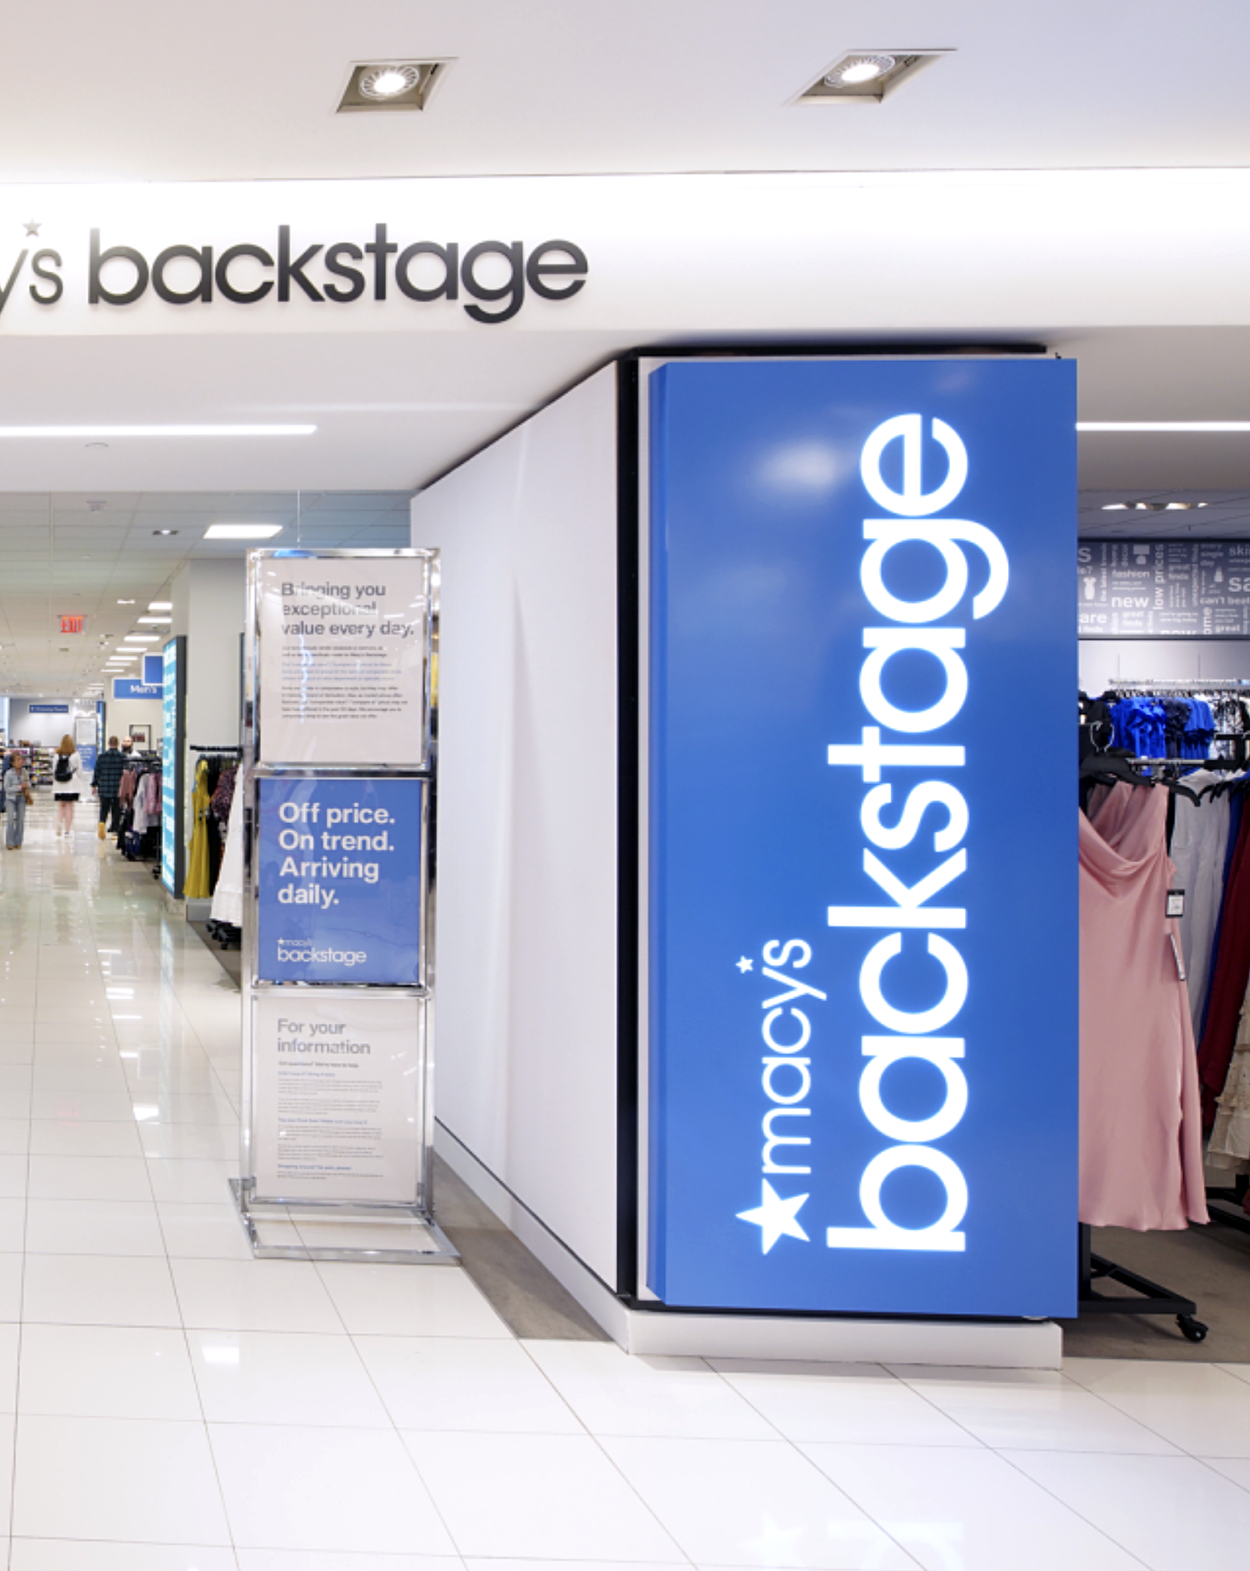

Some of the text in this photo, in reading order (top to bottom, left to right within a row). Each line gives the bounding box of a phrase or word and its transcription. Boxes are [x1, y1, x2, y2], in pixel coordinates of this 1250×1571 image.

[88, 222, 589, 325] backstage
[281, 582, 386, 600] Bringing you
[282, 601, 377, 619] exceptional
[1111, 596, 1150, 608] new
[282, 621, 414, 639] value every day.
[278, 802, 396, 827] Off price.
[278, 829, 395, 852] On trend.
[826, 412, 1010, 1253] backstage
[278, 856, 380, 884] Arriving
[277, 883, 340, 910] daily.
[277, 946, 367, 966] backstage
[277, 1018, 347, 1038] For your
[277, 1037, 371, 1056] information
[736, 937, 828, 1174] macy's
